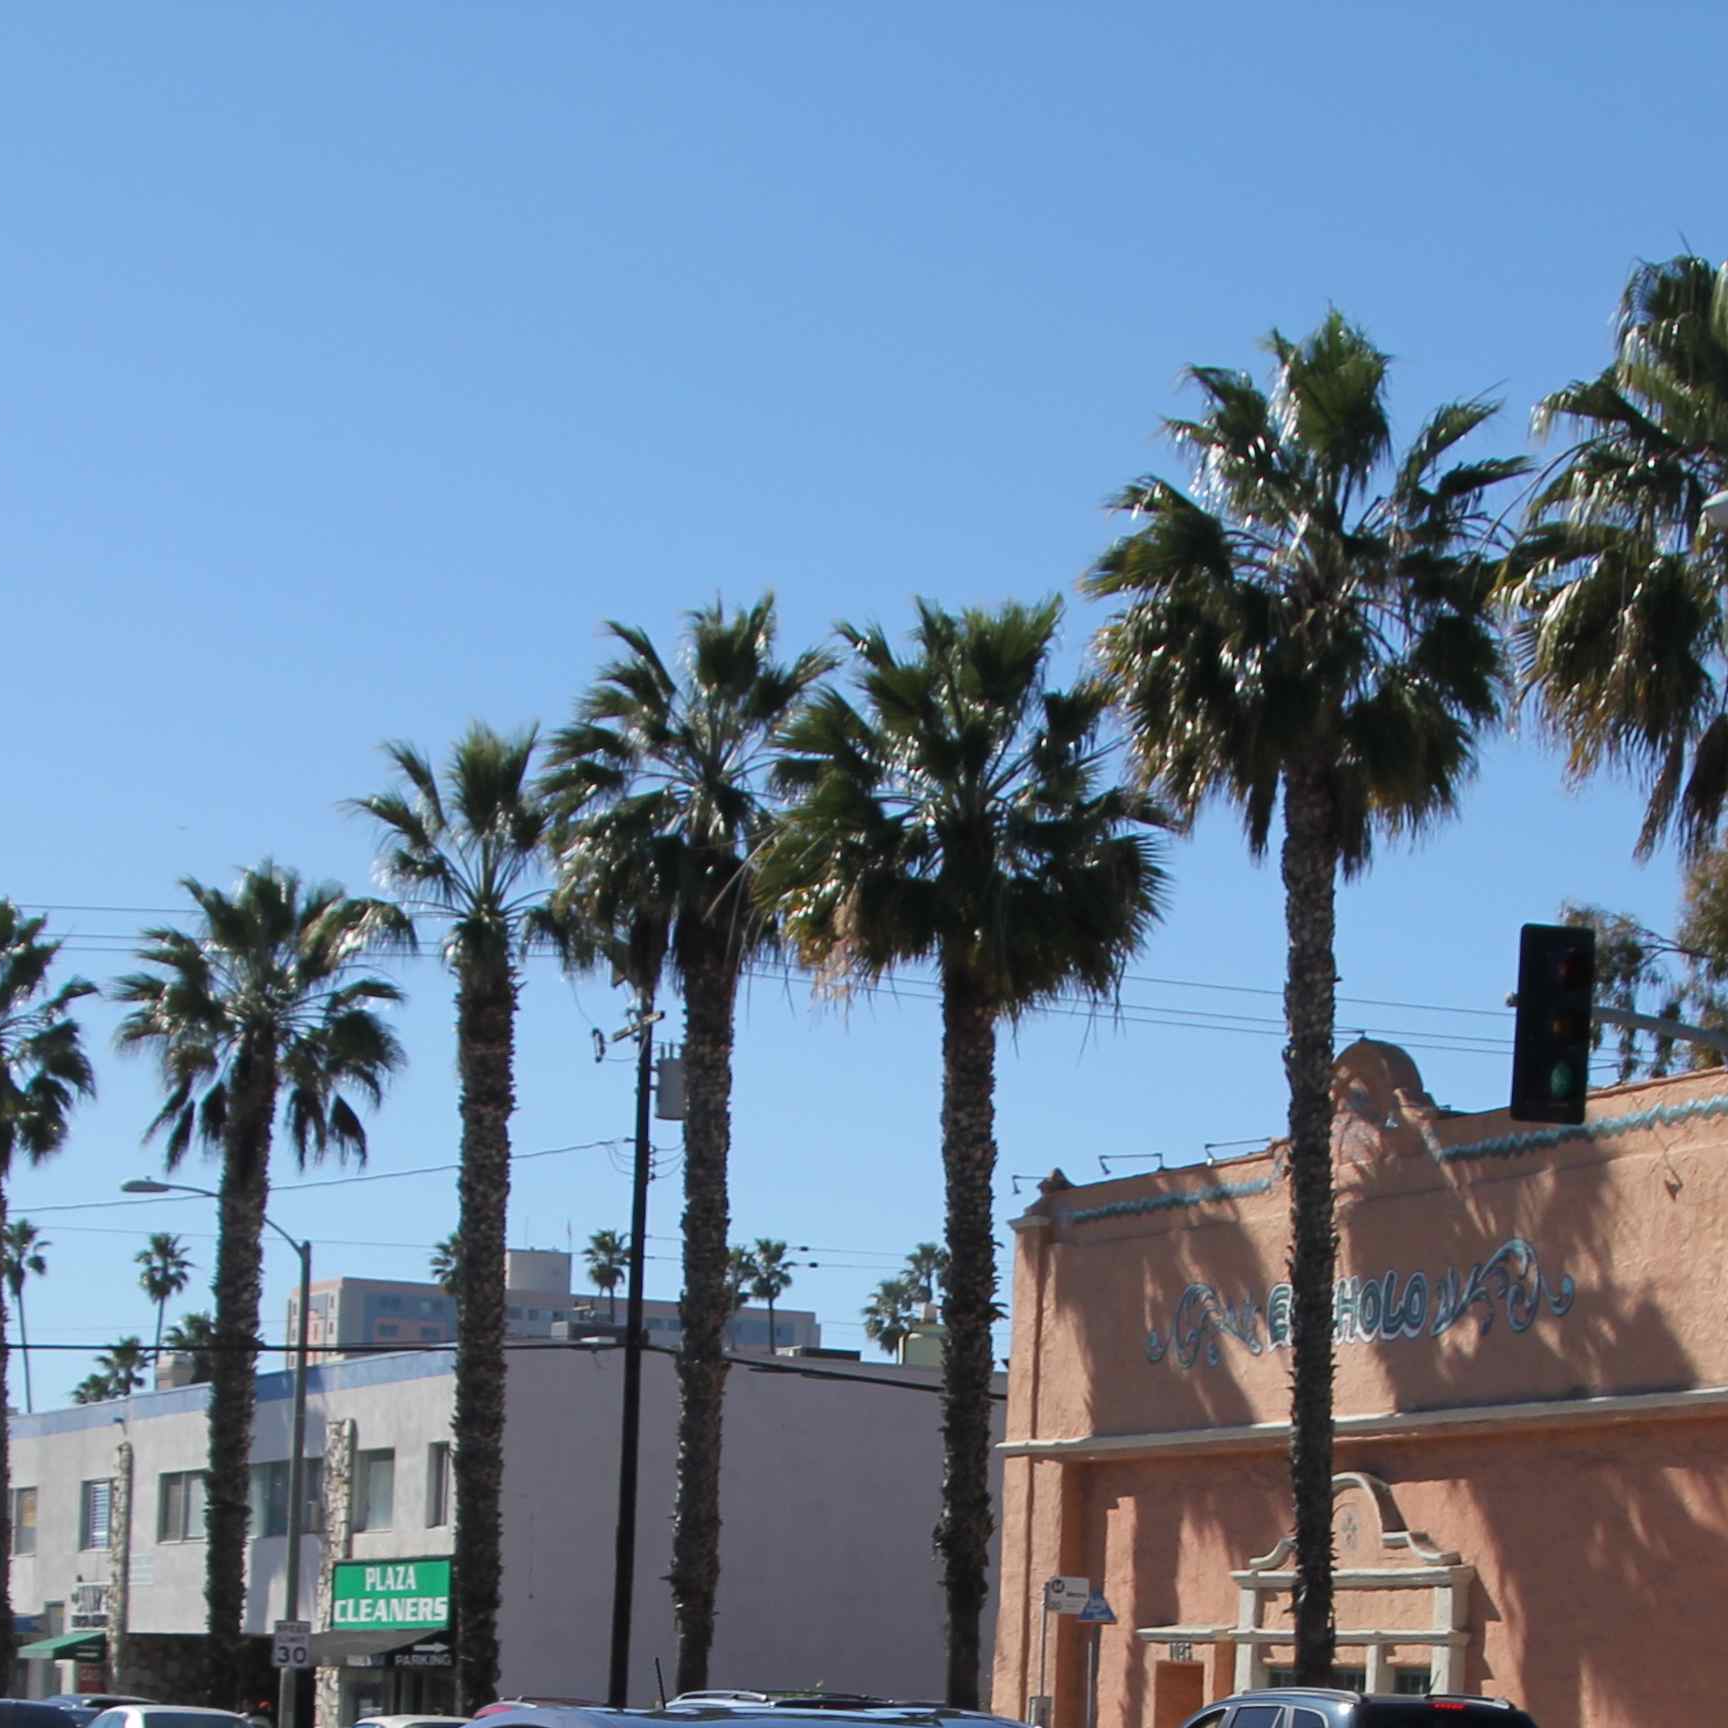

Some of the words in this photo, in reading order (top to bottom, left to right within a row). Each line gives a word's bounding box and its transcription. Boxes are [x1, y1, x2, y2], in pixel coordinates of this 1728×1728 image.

[1332, 1270, 1428, 1344] HOLO
[364, 1566, 417, 1592] PLAZA
[333, 1597, 449, 1623] CLEANERS
[277, 1646, 307, 1664] 30
[394, 1655, 452, 1666] PARKING
